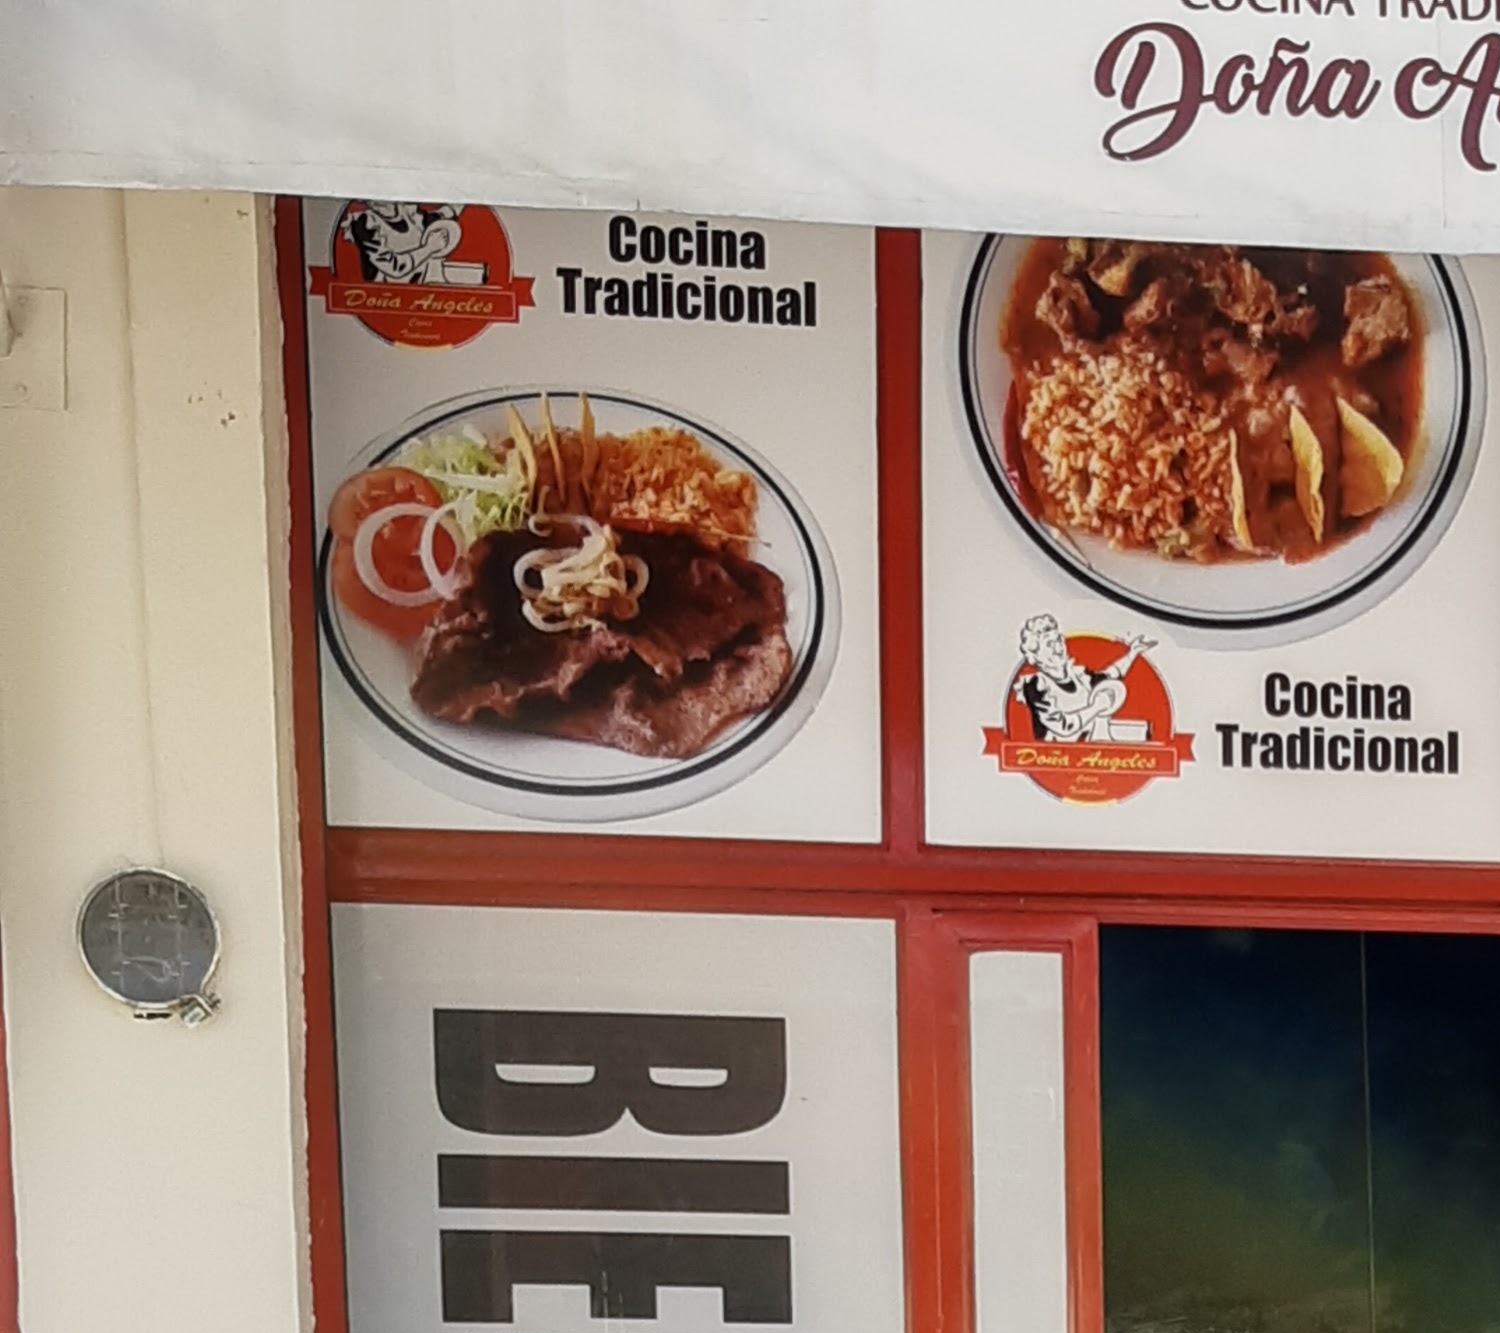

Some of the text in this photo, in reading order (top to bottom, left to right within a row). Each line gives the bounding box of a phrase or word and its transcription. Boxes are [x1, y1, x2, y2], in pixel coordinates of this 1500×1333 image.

[1094, 21, 1382, 162] Doña
[608, 215, 766, 270] Cocina
[344, 289, 493, 315] Doña Angeles
[556, 267, 817, 327] Tradicional
[1265, 672, 1411, 721] Cocina
[1016, 747, 1156, 771] Doña Angeles
[1215, 723, 1459, 774] Tradicional
